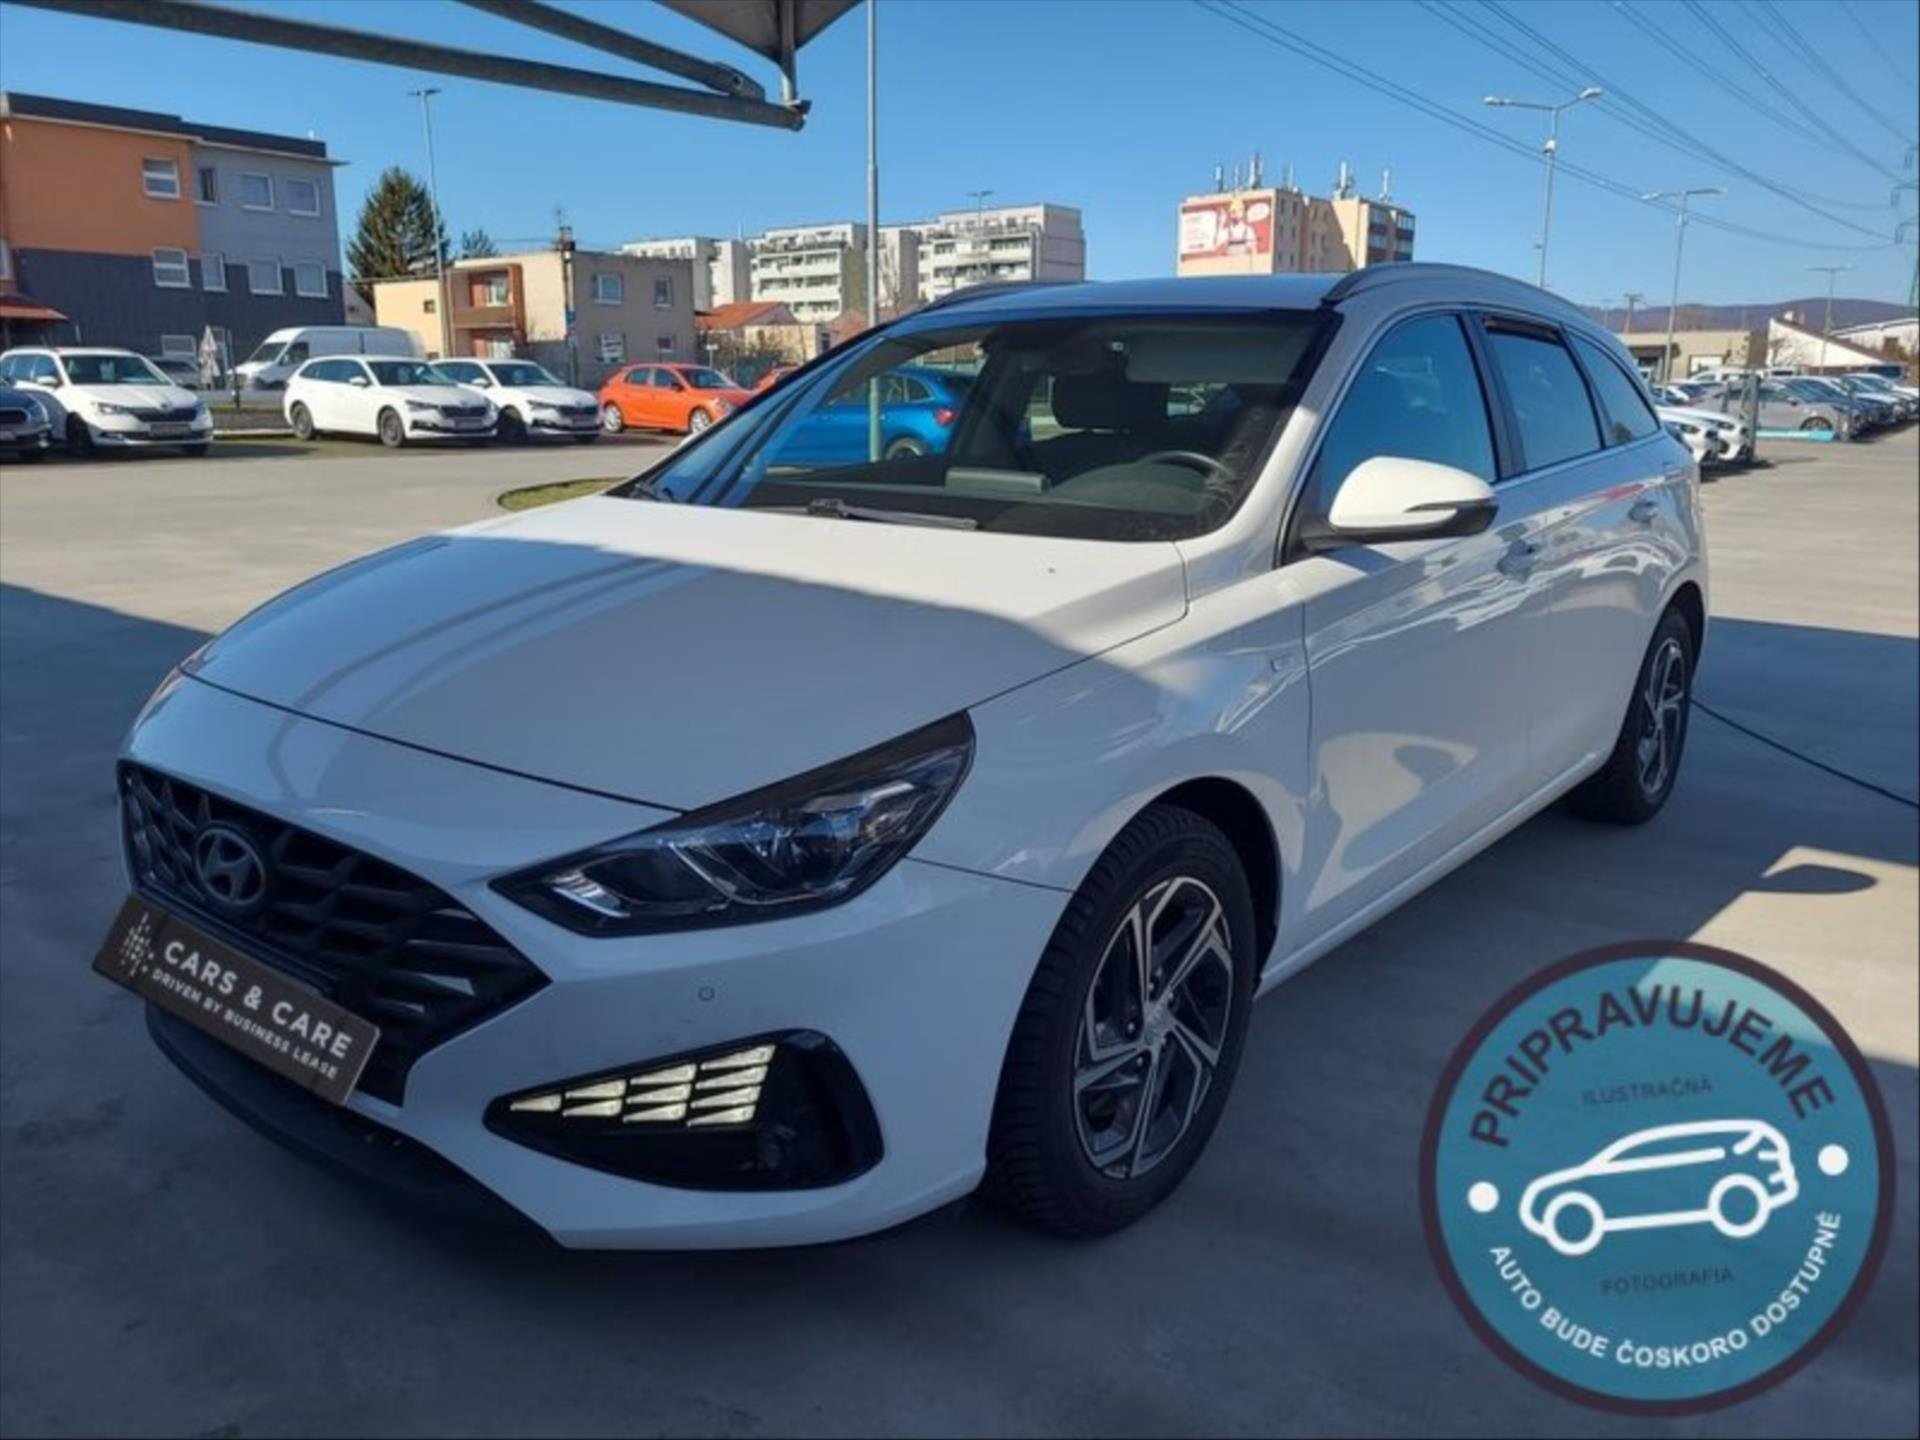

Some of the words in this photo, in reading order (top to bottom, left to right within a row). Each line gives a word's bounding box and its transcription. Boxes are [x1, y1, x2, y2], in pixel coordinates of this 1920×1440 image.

[152, 969, 202, 1003] DRIVEN
[203, 997, 222, 1015] BY
[224, 1008, 290, 1052] BUSINESS
[293, 1046, 339, 1080] LEASE
[164, 941, 237, 994] CARS
[243, 985, 262, 1011] &
[271, 1001, 352, 1059] CARE
